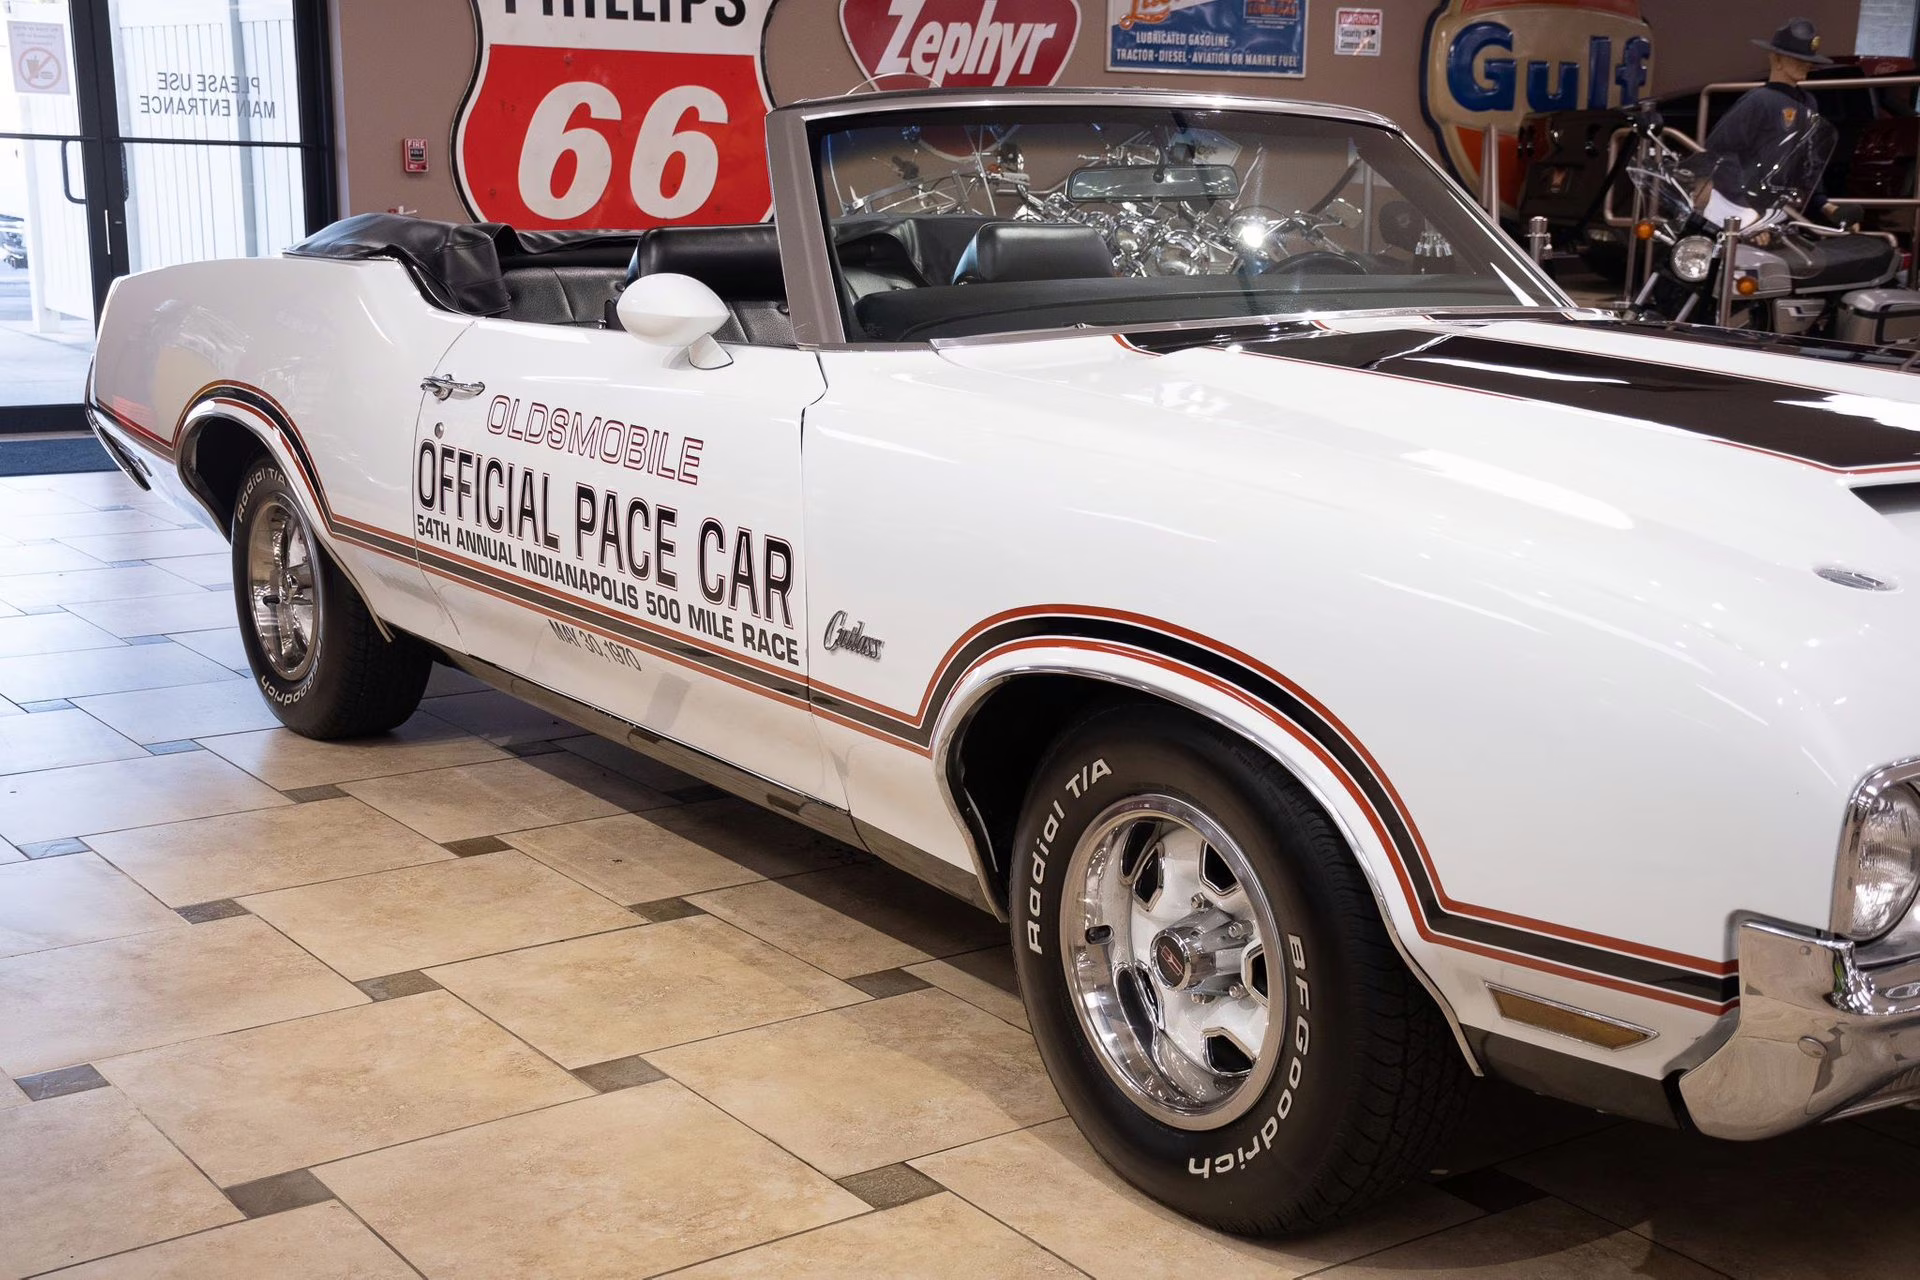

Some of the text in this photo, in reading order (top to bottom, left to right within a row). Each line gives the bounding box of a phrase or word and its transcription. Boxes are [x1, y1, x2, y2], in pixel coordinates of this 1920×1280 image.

[874, 0, 1057, 87] Zephyr
[1117, 49, 1297, 67] TRACTOR DIESEL AVIATION OR MARINE FUEL
[1136, 31, 1229, 47] LUBRICATED GASOLINE
[1446, 20, 1651, 113] Gulf
[518, 81, 729, 220] 66
[486, 394, 704, 486] OLDSMOBILE
[237, 468, 266, 524] Radial
[416, 439, 796, 630] OFFICIAL PACE CAR
[417, 515, 800, 667] 54TH ANNUAL INDIANAPOLIS 500 MILE RACE
[823, 610, 884, 661] Cutlass
[548, 619, 582, 649] MAY
[604, 640, 642, 672] 1970
[1027, 758, 1113, 955] Radial T/A
[1188, 932, 1312, 1180] BFGoodrich
